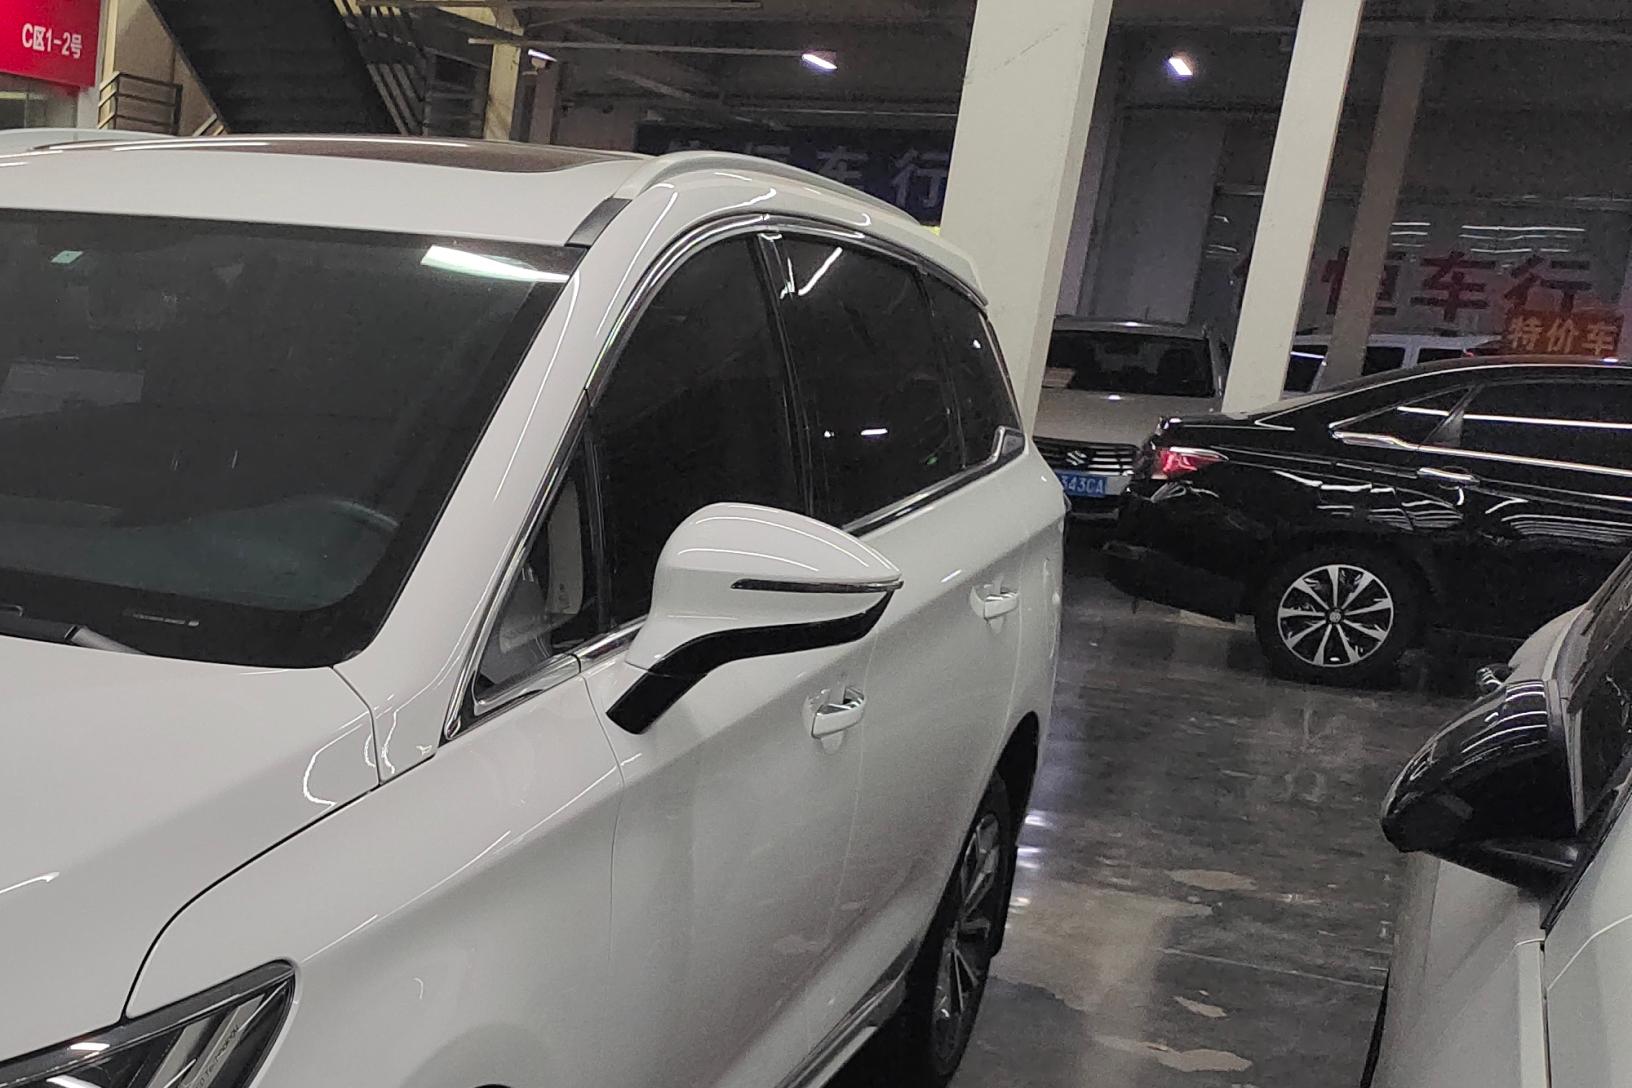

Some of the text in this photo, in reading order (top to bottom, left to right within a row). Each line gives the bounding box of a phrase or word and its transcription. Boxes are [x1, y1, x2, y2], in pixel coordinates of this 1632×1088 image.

[22, 22, 82, 59] C区1-2号
[1508, 317, 1618, 355] 特价车
